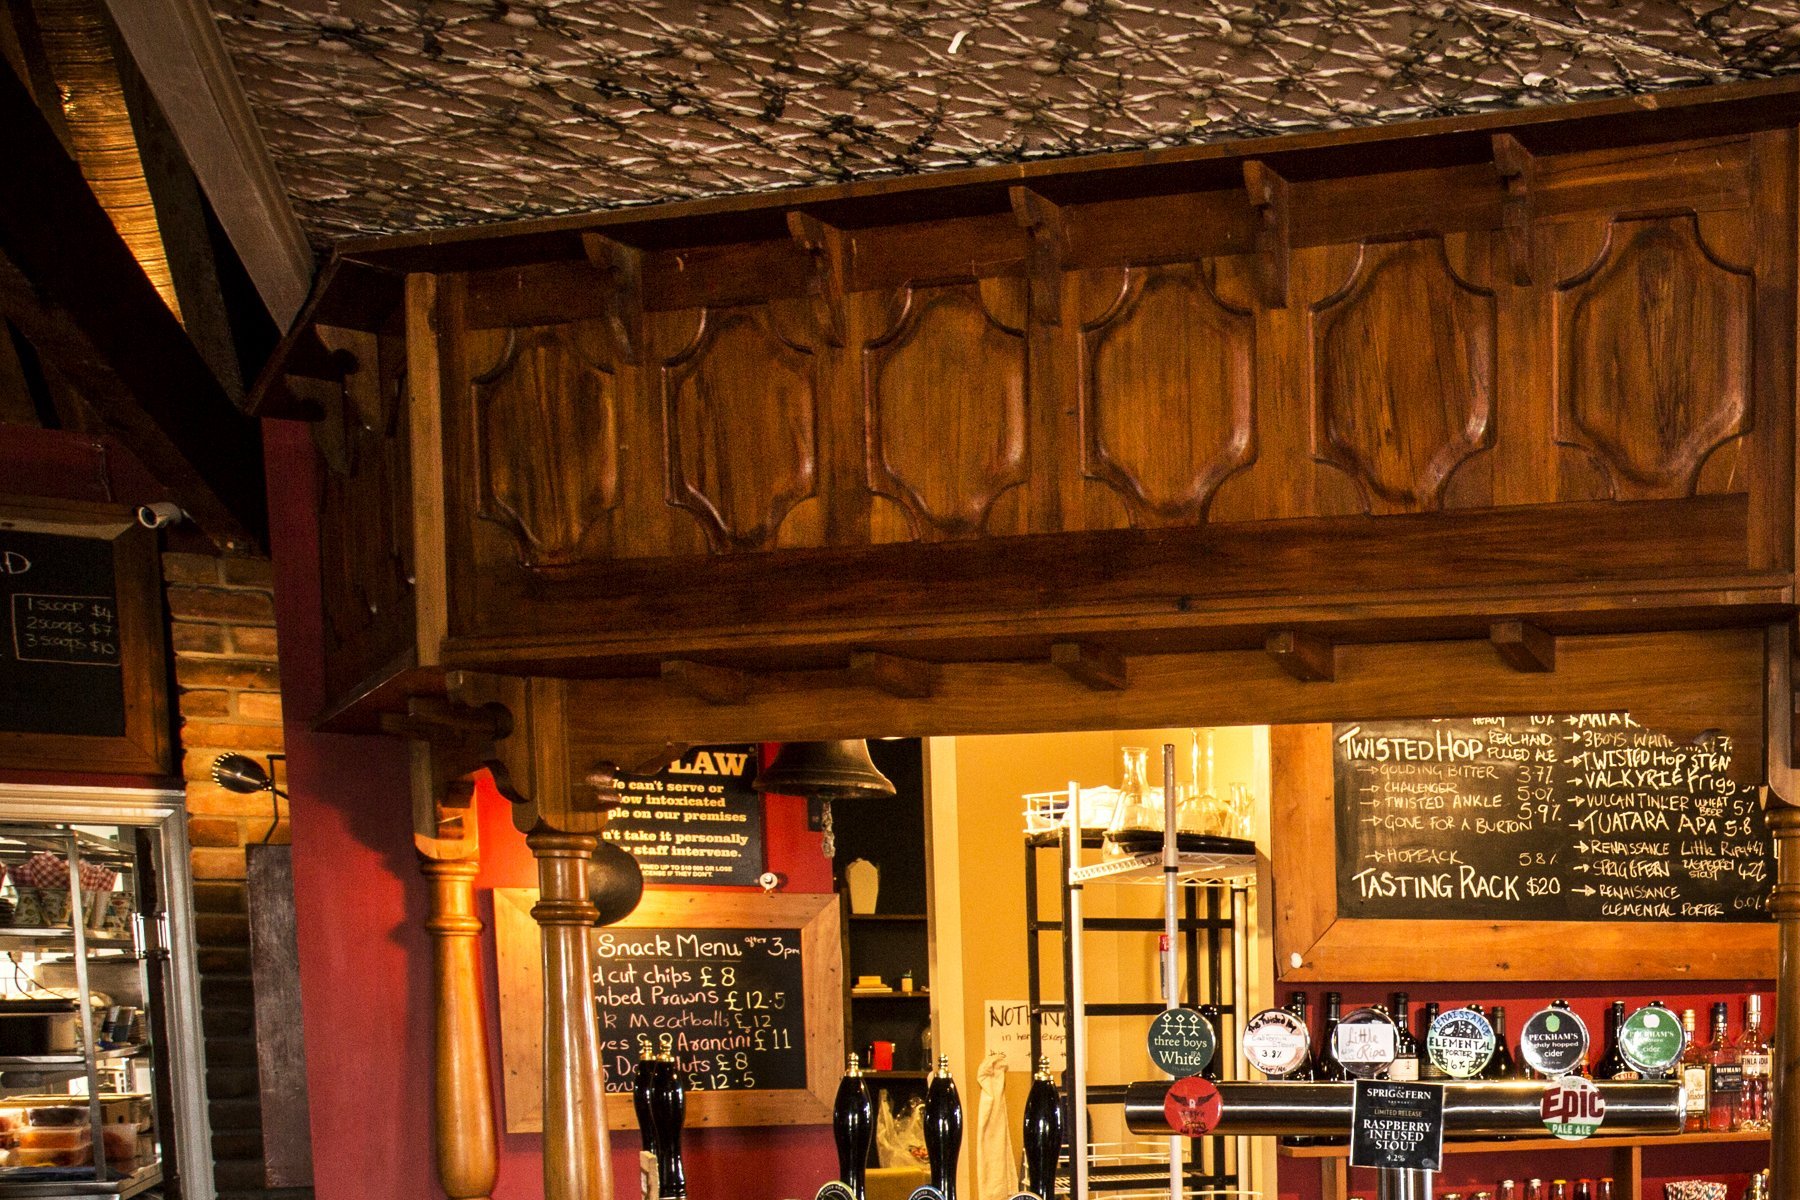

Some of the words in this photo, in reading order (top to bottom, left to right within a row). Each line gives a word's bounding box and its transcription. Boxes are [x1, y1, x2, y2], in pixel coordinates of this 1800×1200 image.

[1338, 725, 1435, 763] TWISTED
[1436, 729, 1483, 763] HOP
[1487, 729, 1520, 748] REAL
[1520, 731, 1553, 747] HAND
[667, 750, 750, 777] LAW
[1534, 749, 1559, 763] ALE
[1578, 748, 1651, 771] TWISTED
[1379, 764, 1443, 780] GOLDING
[1449, 765, 1500, 780] BITTER
[1584, 767, 1684, 791] VALKYRIE
[628, 779, 664, 792] can't
[666, 781, 705, 793] serve
[708, 784, 725, 794] or
[1383, 781, 1460, 795] CHALLENGER
[645, 793, 727, 808] intoxicated
[1385, 795, 1445, 810] TWISTED
[1452, 794, 1503, 809] ANKLE
[1586, 793, 1635, 810] VULCAN
[632, 809, 652, 820] on
[654, 809, 681, 821] our
[682, 810, 748, 823] premises
[1583, 809, 1670, 836] TUATARA
[1677, 813, 1718, 836] APA
[1384, 814, 1425, 831] GONE
[1429, 817, 1456, 831] FOR
[1460, 817, 1471, 831] A
[1475, 818, 1533, 835] BURTON
[623, 829, 657, 842] take
[659, 830, 672, 842] it
[675, 832, 750, 847] personally
[633, 844, 670, 856] staff
[671, 845, 743, 858] intervene.
[1590, 839, 1671, 857] RENAISSANCE
[1351, 867, 1454, 899] TASTING
[1459, 865, 1521, 902] RACK
[1526, 875, 1562, 897] $20
[1599, 883, 1681, 900] RENAISSANCE
[1601, 901, 1677, 918] ELEMENTAL
[1680, 901, 1725, 917] PORTER
[597, 932, 674, 959] Snack
[675, 933, 743, 958] Menu
[743, 935, 768, 949] after
[607, 962, 638, 985] cut
[643, 963, 693, 989] chips
[651, 985, 720, 1006] Prawns
[629, 1010, 731, 1030] Meatballs
[1432, 1010, 1492, 1037] RENAISSANCE
[677, 1027, 751, 1052] Arancini
[753, 1027, 793, 1052] £11
[1001, 1033, 1012, 1042] in
[1153, 1035, 1181, 1048] three
[1182, 1035, 1209, 1051] boys
[1346, 1026, 1379, 1047] Little
[1428, 1036, 1493, 1052] ELEMENTAL
[1528, 1032, 1579, 1042] PECKHAM'S
[1158, 1050, 1202, 1066] White
[1444, 1049, 1474, 1059] PORTER
[1543, 1049, 1565, 1058] cider
[1374, 1108, 1398, 1116] LIMITED
[1397, 1109, 1423, 1118] RELEASE
[1362, 1118, 1432, 1133] RASPBERRY
[1552, 1124, 1574, 1134] PALE
[1575, 1124, 1592, 1136] ALE
[1369, 1129, 1424, 1142] INFUSED
[1375, 1139, 1418, 1152] STOUT
[1386, 1154, 1406, 1162] 4.2%
